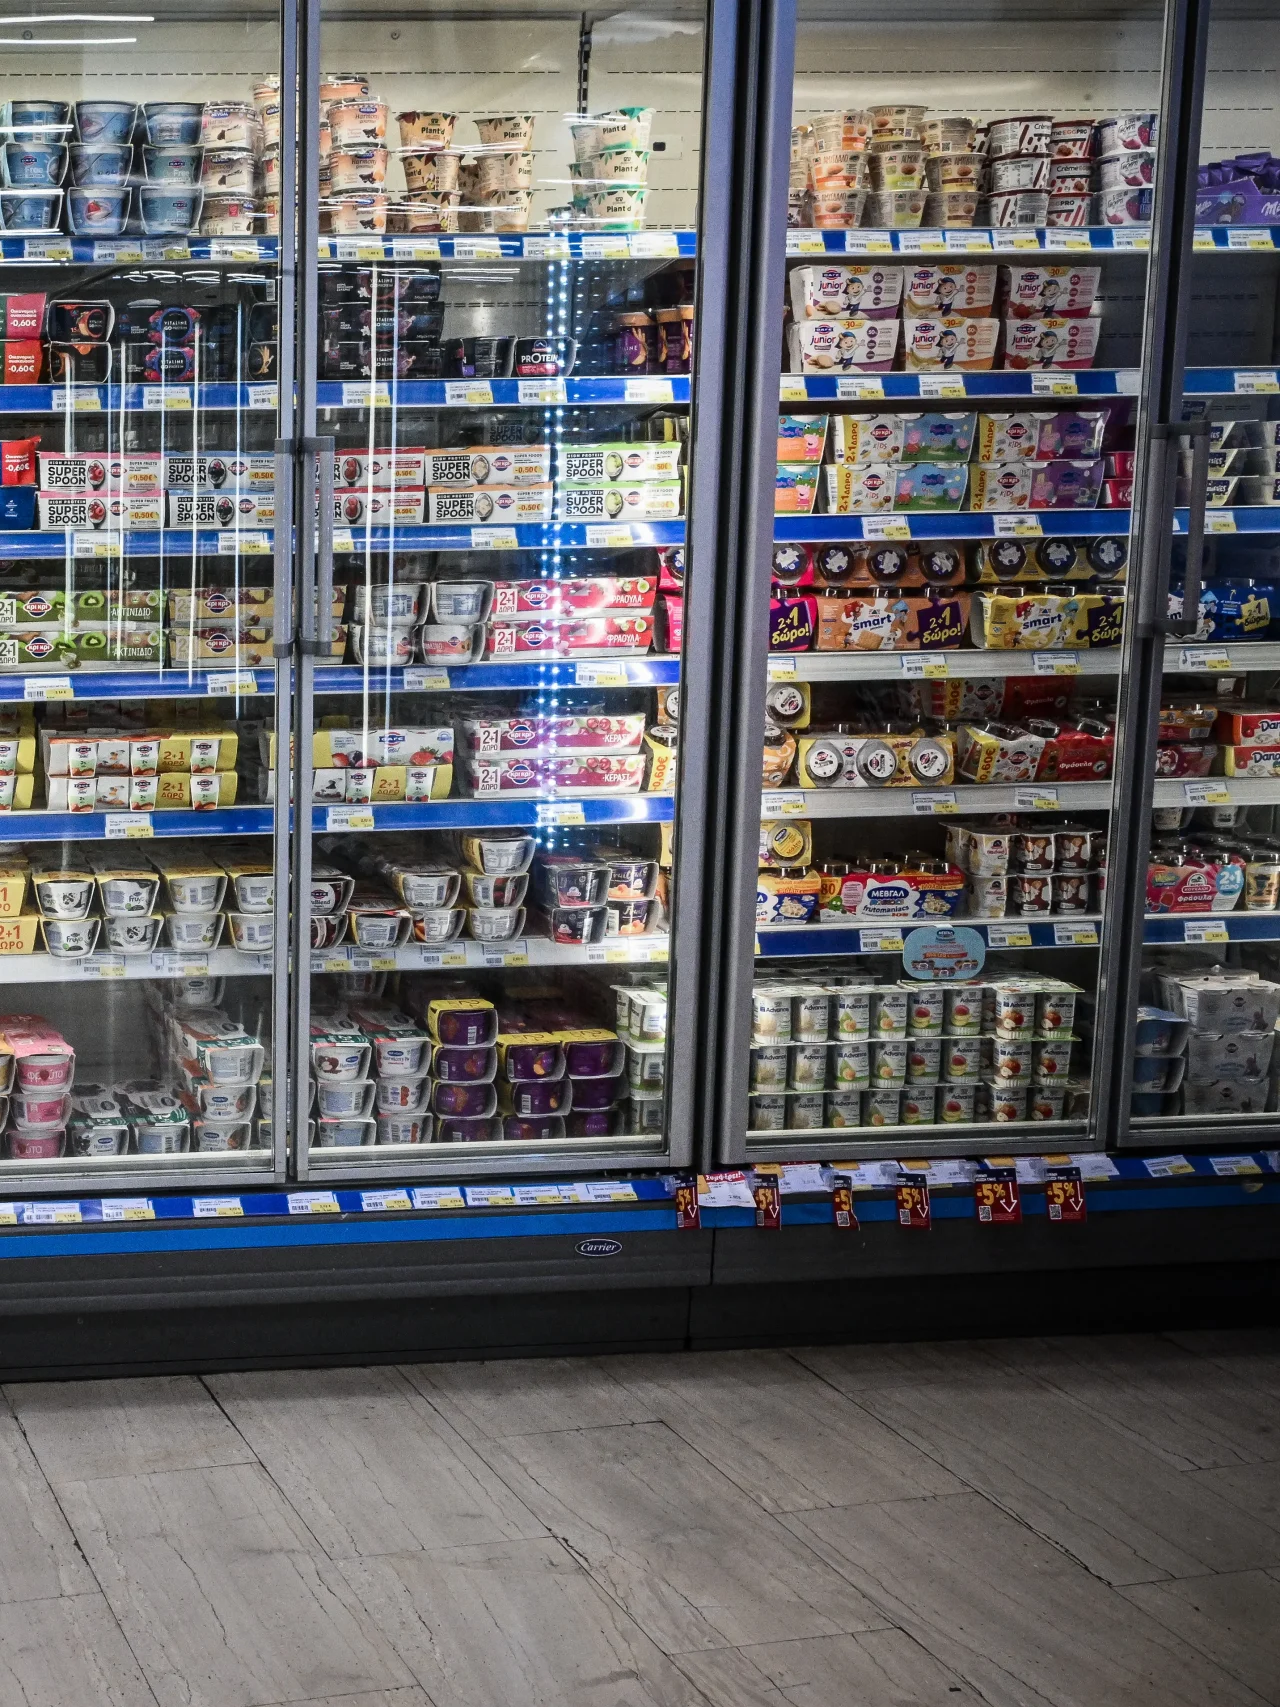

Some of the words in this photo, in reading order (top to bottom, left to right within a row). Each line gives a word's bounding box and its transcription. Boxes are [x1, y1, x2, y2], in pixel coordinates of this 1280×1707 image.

[818, 280, 844, 292] junior
[908, 280, 936, 290] junior
[1016, 282, 1040, 294] junior
[810, 334, 835, 346] junior
[912, 334, 938, 345] junior
[1012, 334, 1038, 345] junior
[432, 462, 470, 472] SUPER
[566, 459, 603, 469] SUPER
[48, 467, 86, 476] SUPER
[169, 464, 207, 475] SUPER
[514, 466, 540, 475] -0,50€
[566, 469, 603, 478] SPOON
[48, 476, 86, 485] SPOON
[168, 475, 207, 483] SPOON
[432, 472, 470, 480] SPOON
[436, 500, 474, 510] SUPER
[518, 503, 541, 512] -0,50€
[566, 498, 603, 507] SUPER
[48, 506, 86, 515] SUPER
[177, 503, 215, 513] SUPER
[566, 507, 603, 516] SPOON
[48, 515, 86, 524] SPOON
[177, 513, 215, 521] SPOON
[499, 590, 516, 606] 2+1
[112, 608, 150, 617] ΑΚΤΙΝΙΔΙΟ
[853, 613, 892, 631] smart
[1022, 613, 1063, 631] smart
[497, 630, 515, 645] 2+1
[771, 627, 810, 645] δώρο!
[922, 627, 962, 645] δώρο!
[482, 730, 499, 744] 2+1
[871, 890, 905, 898] ΜΕΒΓΑΛ
[862, 905, 910, 913] frutomaniacs
[580, 1242, 618, 1253] Carrier
